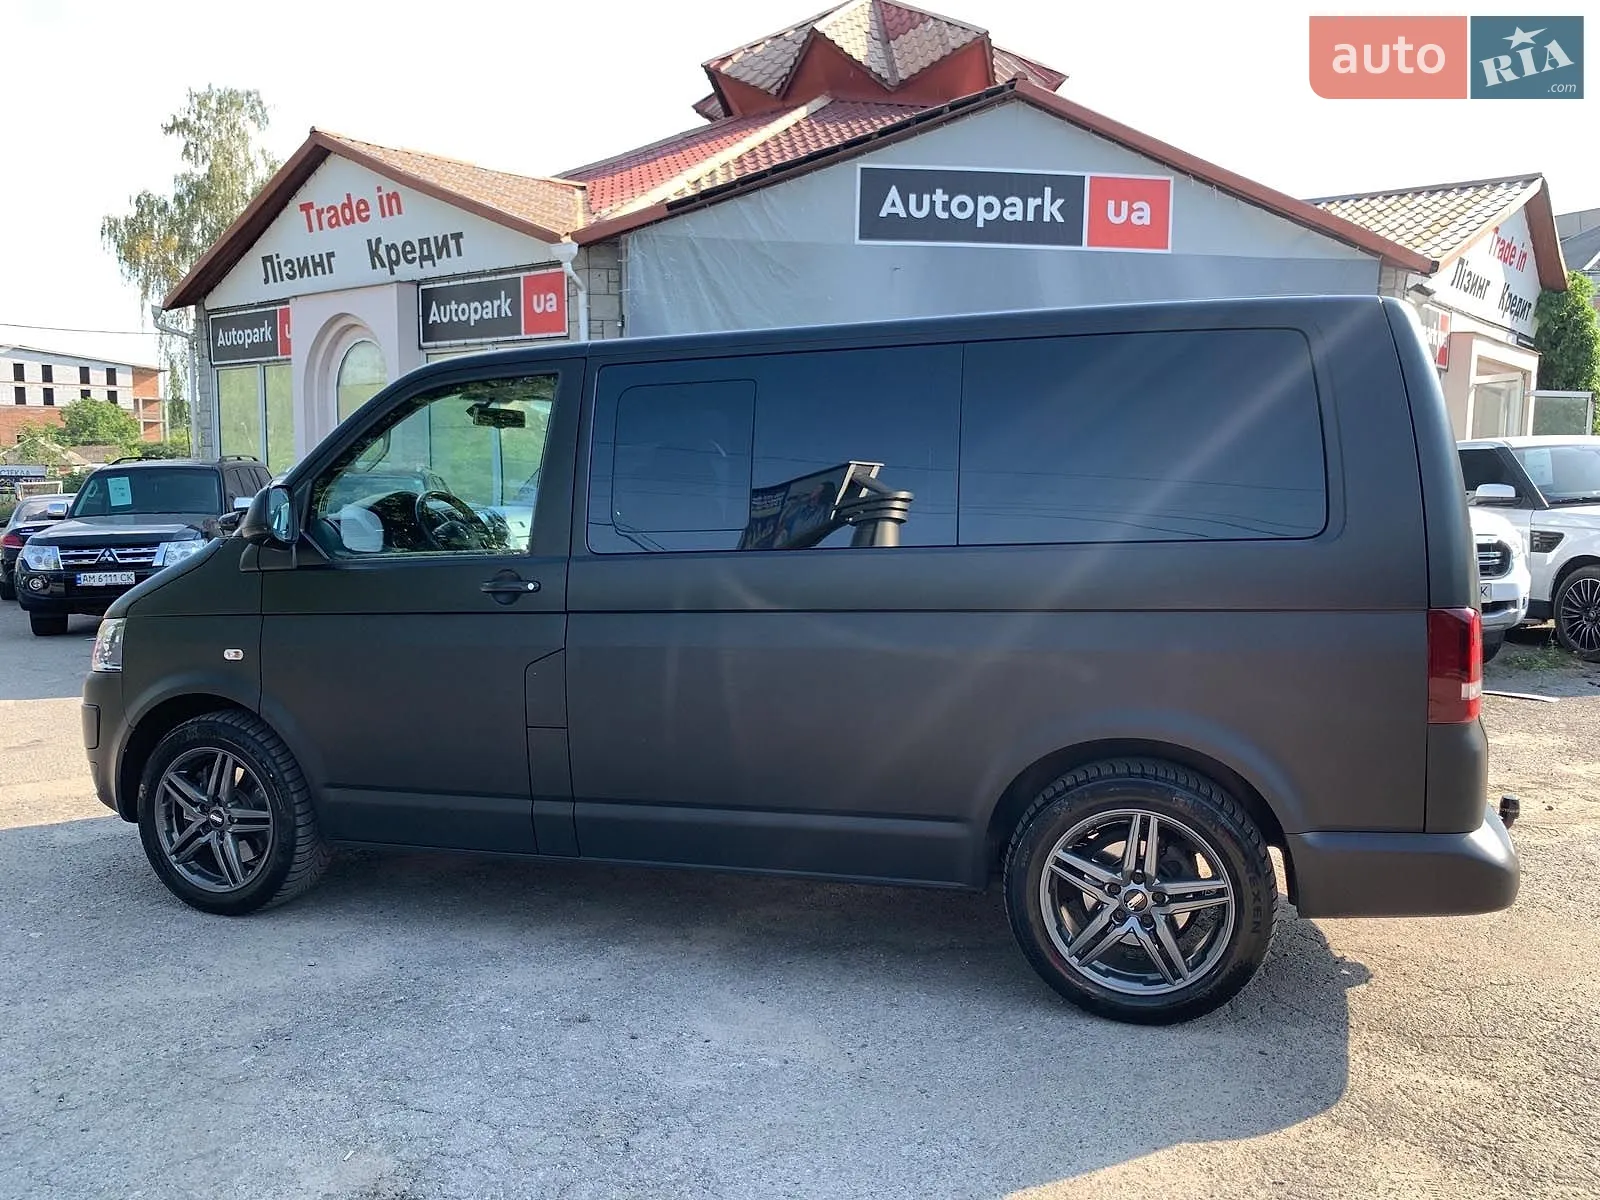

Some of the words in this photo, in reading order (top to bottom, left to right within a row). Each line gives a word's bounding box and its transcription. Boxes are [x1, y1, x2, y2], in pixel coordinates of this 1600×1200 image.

[299, 193, 370, 233] Trade
[377, 186, 404, 218] in
[879, 184, 1065, 228] Autopark
[1107, 199, 1152, 225] ua
[261, 251, 336, 285] Лізинг
[366, 231, 464, 275] Кредит
[1489, 226, 1516, 267] Trade
[1516, 243, 1528, 272] in
[429, 290, 512, 325] Autopark
[533, 292, 557, 313] ua
[1451, 256, 1491, 300] Лізинг
[1498, 282, 1532, 323] Кредит
[217, 319, 272, 349] Autopark
[83, 574, 96, 583] AM
[98, 573, 117, 583] 6111
[120, 573, 133, 582] CK
